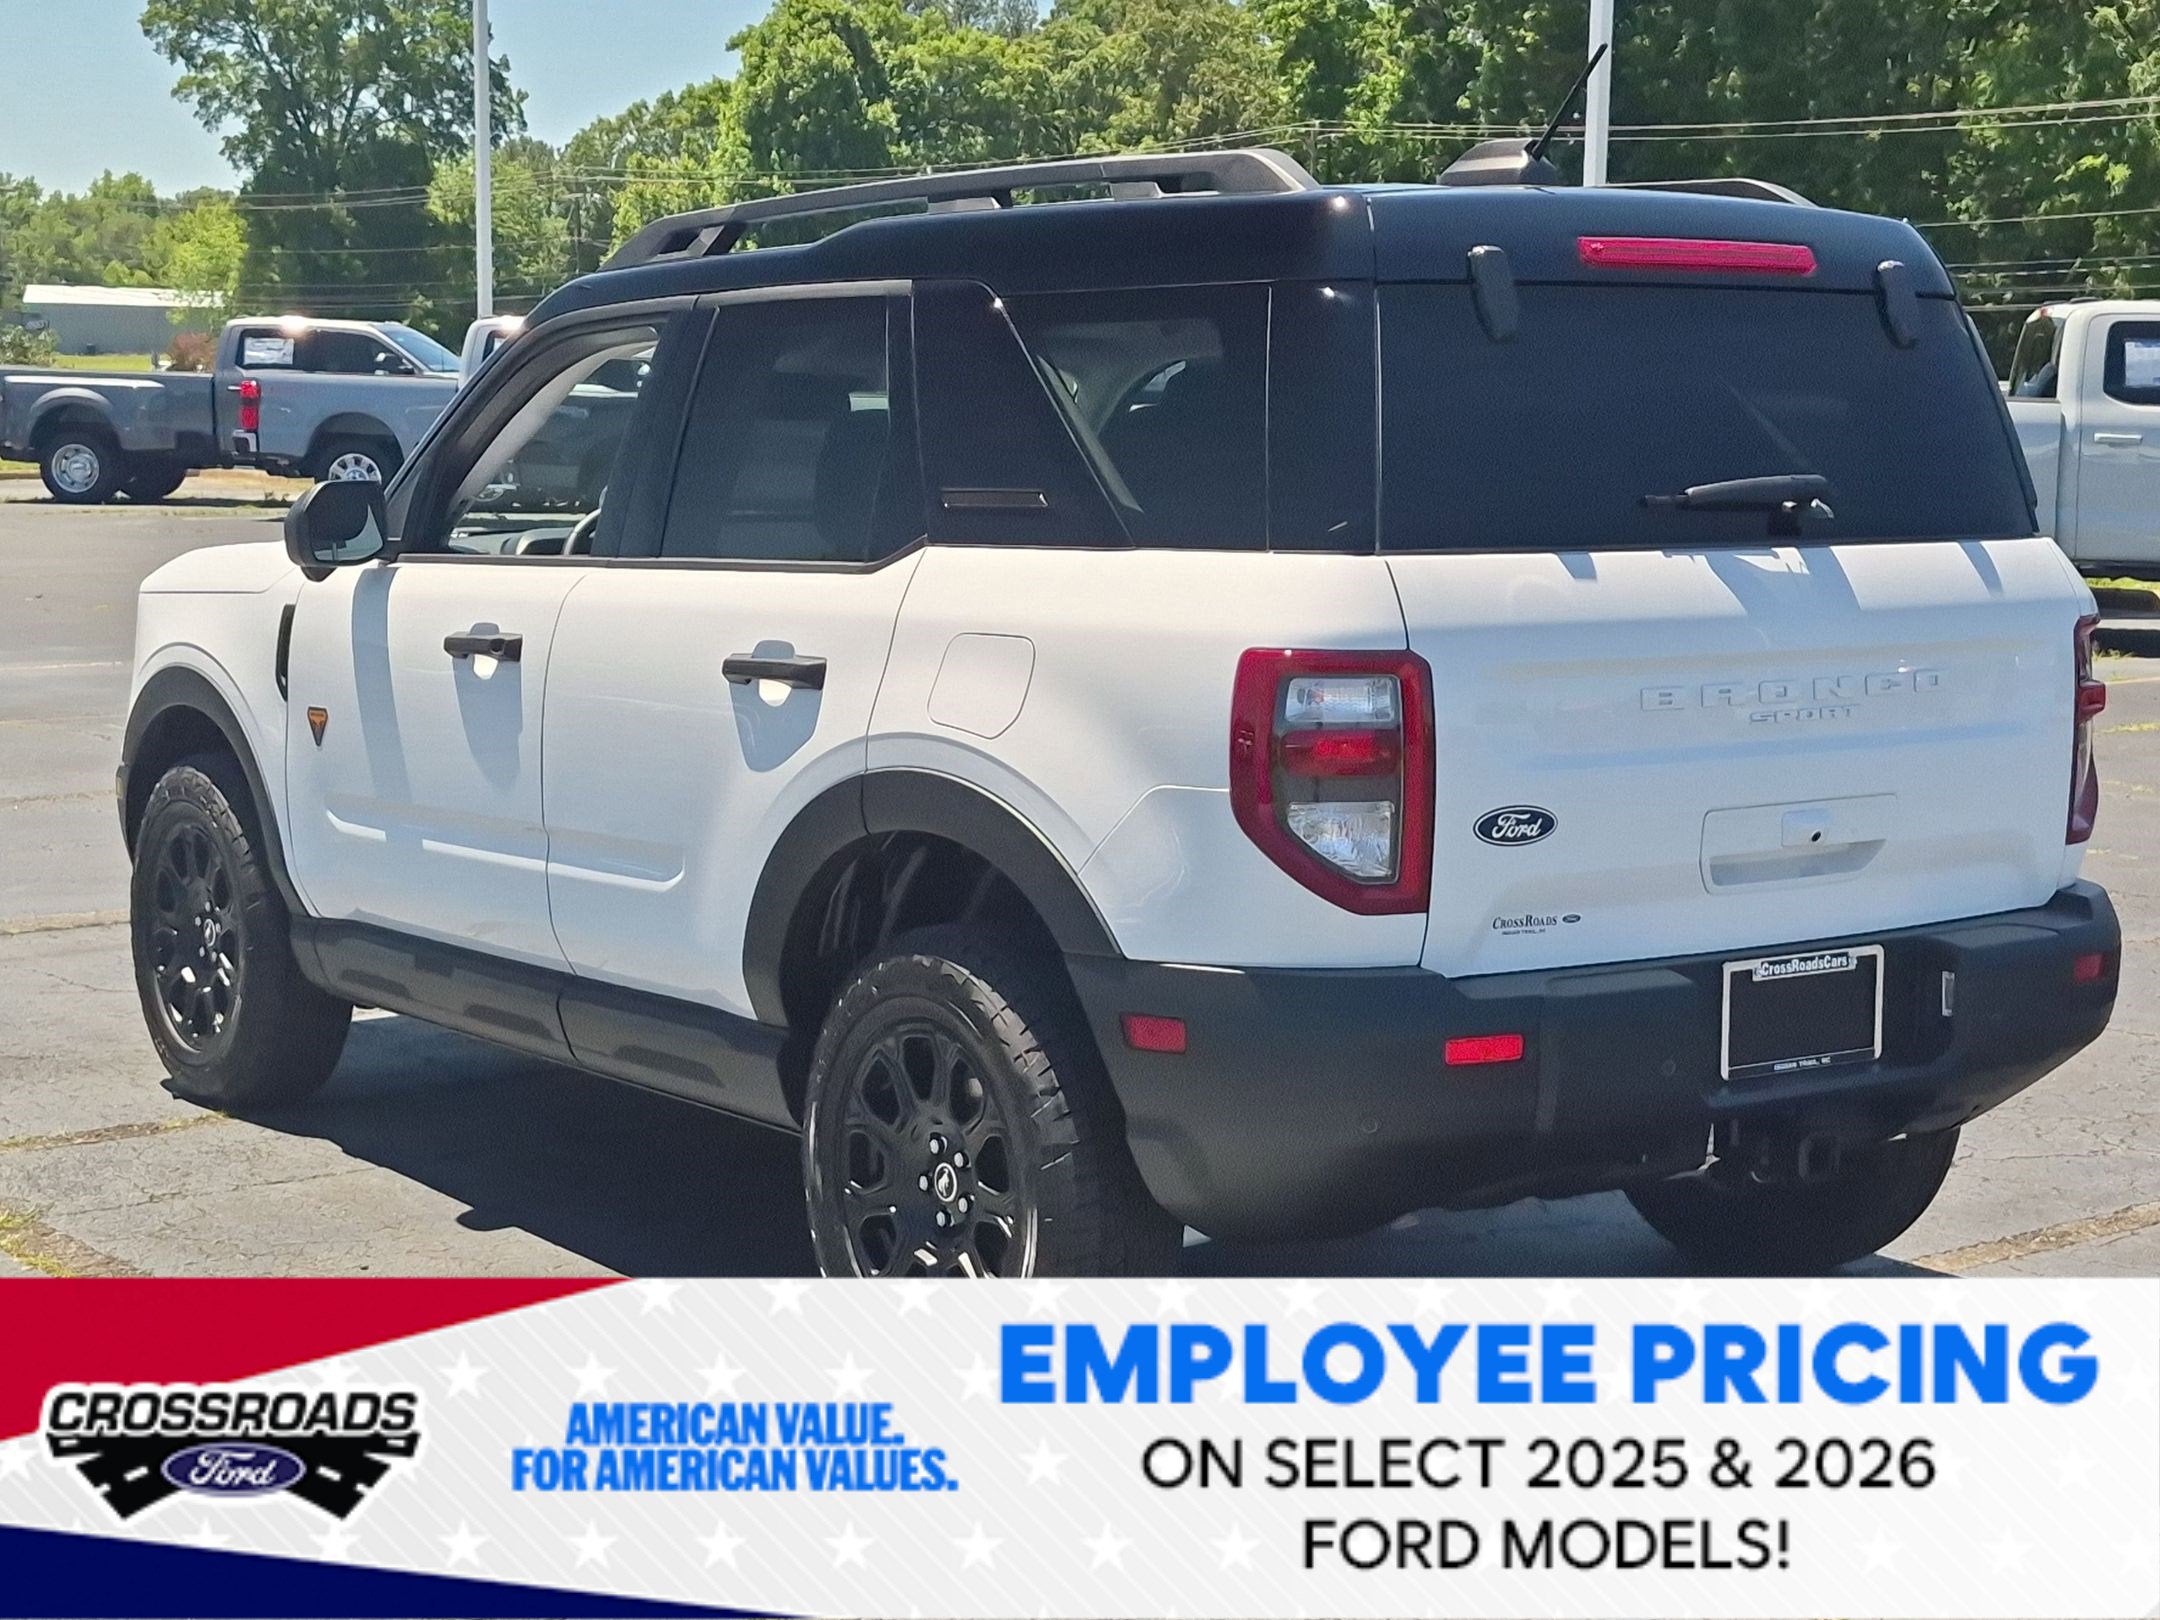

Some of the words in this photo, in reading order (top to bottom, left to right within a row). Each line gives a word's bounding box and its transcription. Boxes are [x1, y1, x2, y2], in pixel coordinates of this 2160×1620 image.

[1640, 668, 1949, 711] BRONCO
[1750, 703, 1862, 722] SPORT
[1491, 813, 1543, 839] Ford
[1761, 954, 1848, 977] CrossRoadsCars
